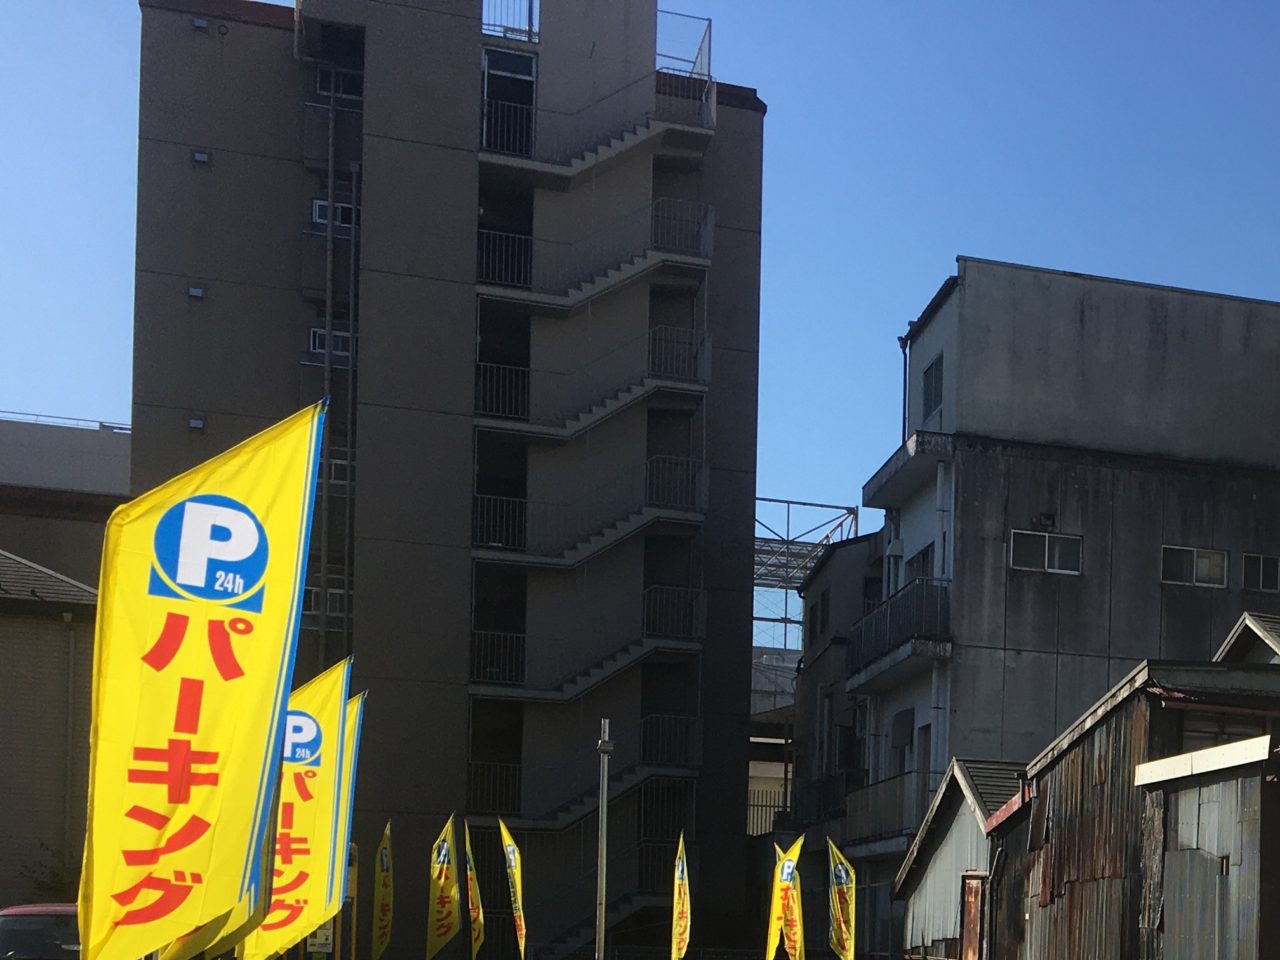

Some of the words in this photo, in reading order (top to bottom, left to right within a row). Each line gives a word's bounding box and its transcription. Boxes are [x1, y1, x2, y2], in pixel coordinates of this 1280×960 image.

[176, 502, 259, 588] P
[214, 570, 244, 595] 24h
[284, 715, 317, 757] P
[111, 611, 254, 926] パーキング
